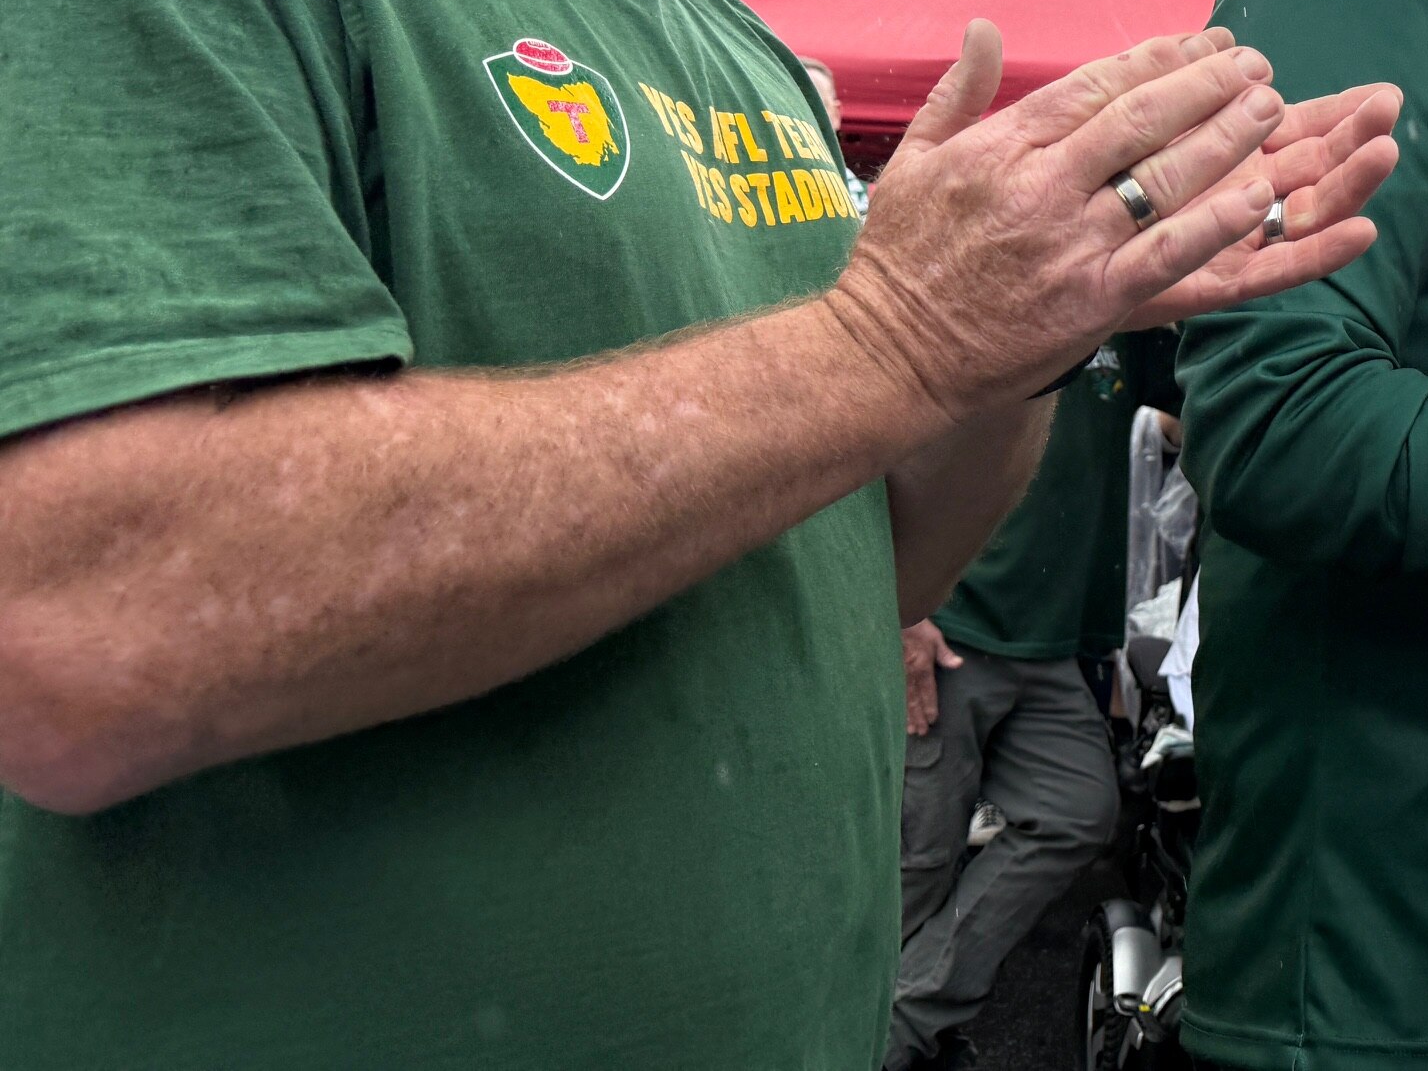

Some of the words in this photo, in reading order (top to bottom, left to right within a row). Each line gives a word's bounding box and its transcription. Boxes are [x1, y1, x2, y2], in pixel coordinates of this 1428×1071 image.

[546, 100, 590, 144] T
[638, 81, 704, 155] YES
[709, 105, 768, 164] AFL
[681, 149, 733, 224] YES
